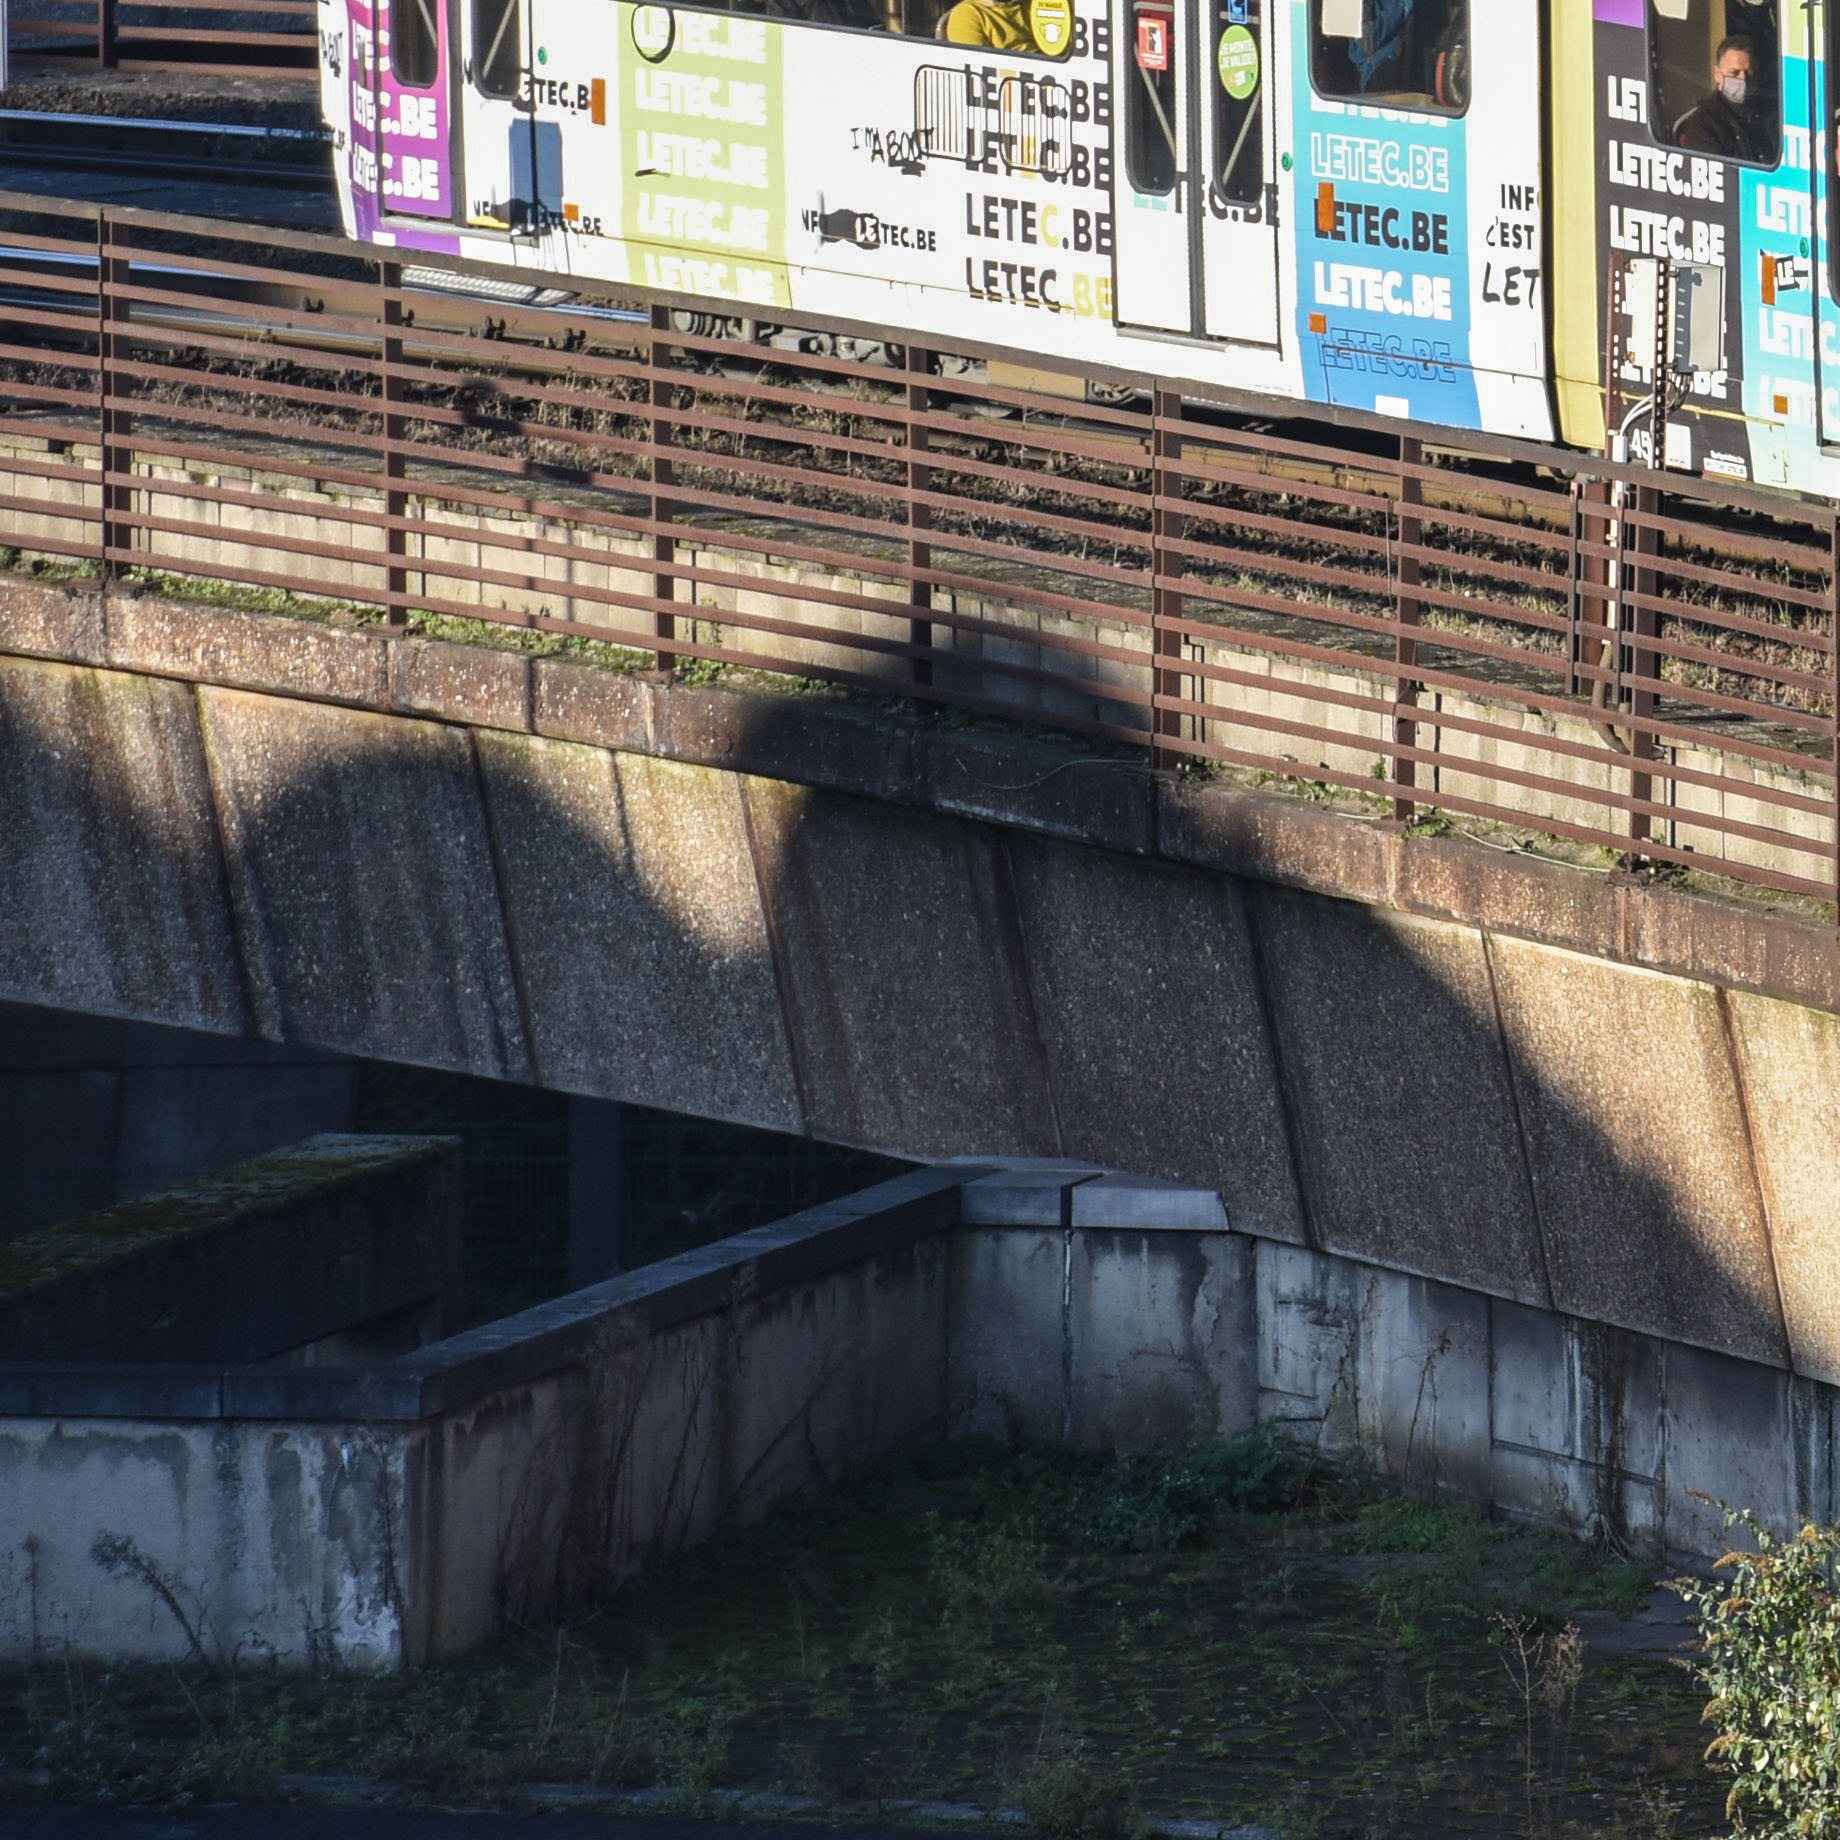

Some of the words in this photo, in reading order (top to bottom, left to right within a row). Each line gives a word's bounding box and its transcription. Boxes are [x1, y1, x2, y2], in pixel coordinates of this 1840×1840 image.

[634, 66, 768, 127] LETEC.BE
[635, 128, 769, 189] LETEC.BE
[1311, 132, 1449, 192] LETEC.BE
[1608, 139, 1726, 204] LETEC.BE
[638, 190, 770, 251] LETEC.BE
[966, 193, 1113, 256] LETEC.BE
[1609, 204, 1727, 267] LETEC.BE
[966, 257, 1113, 319] LETEC.BE
[1313, 261, 1453, 321] LETEC.BE
